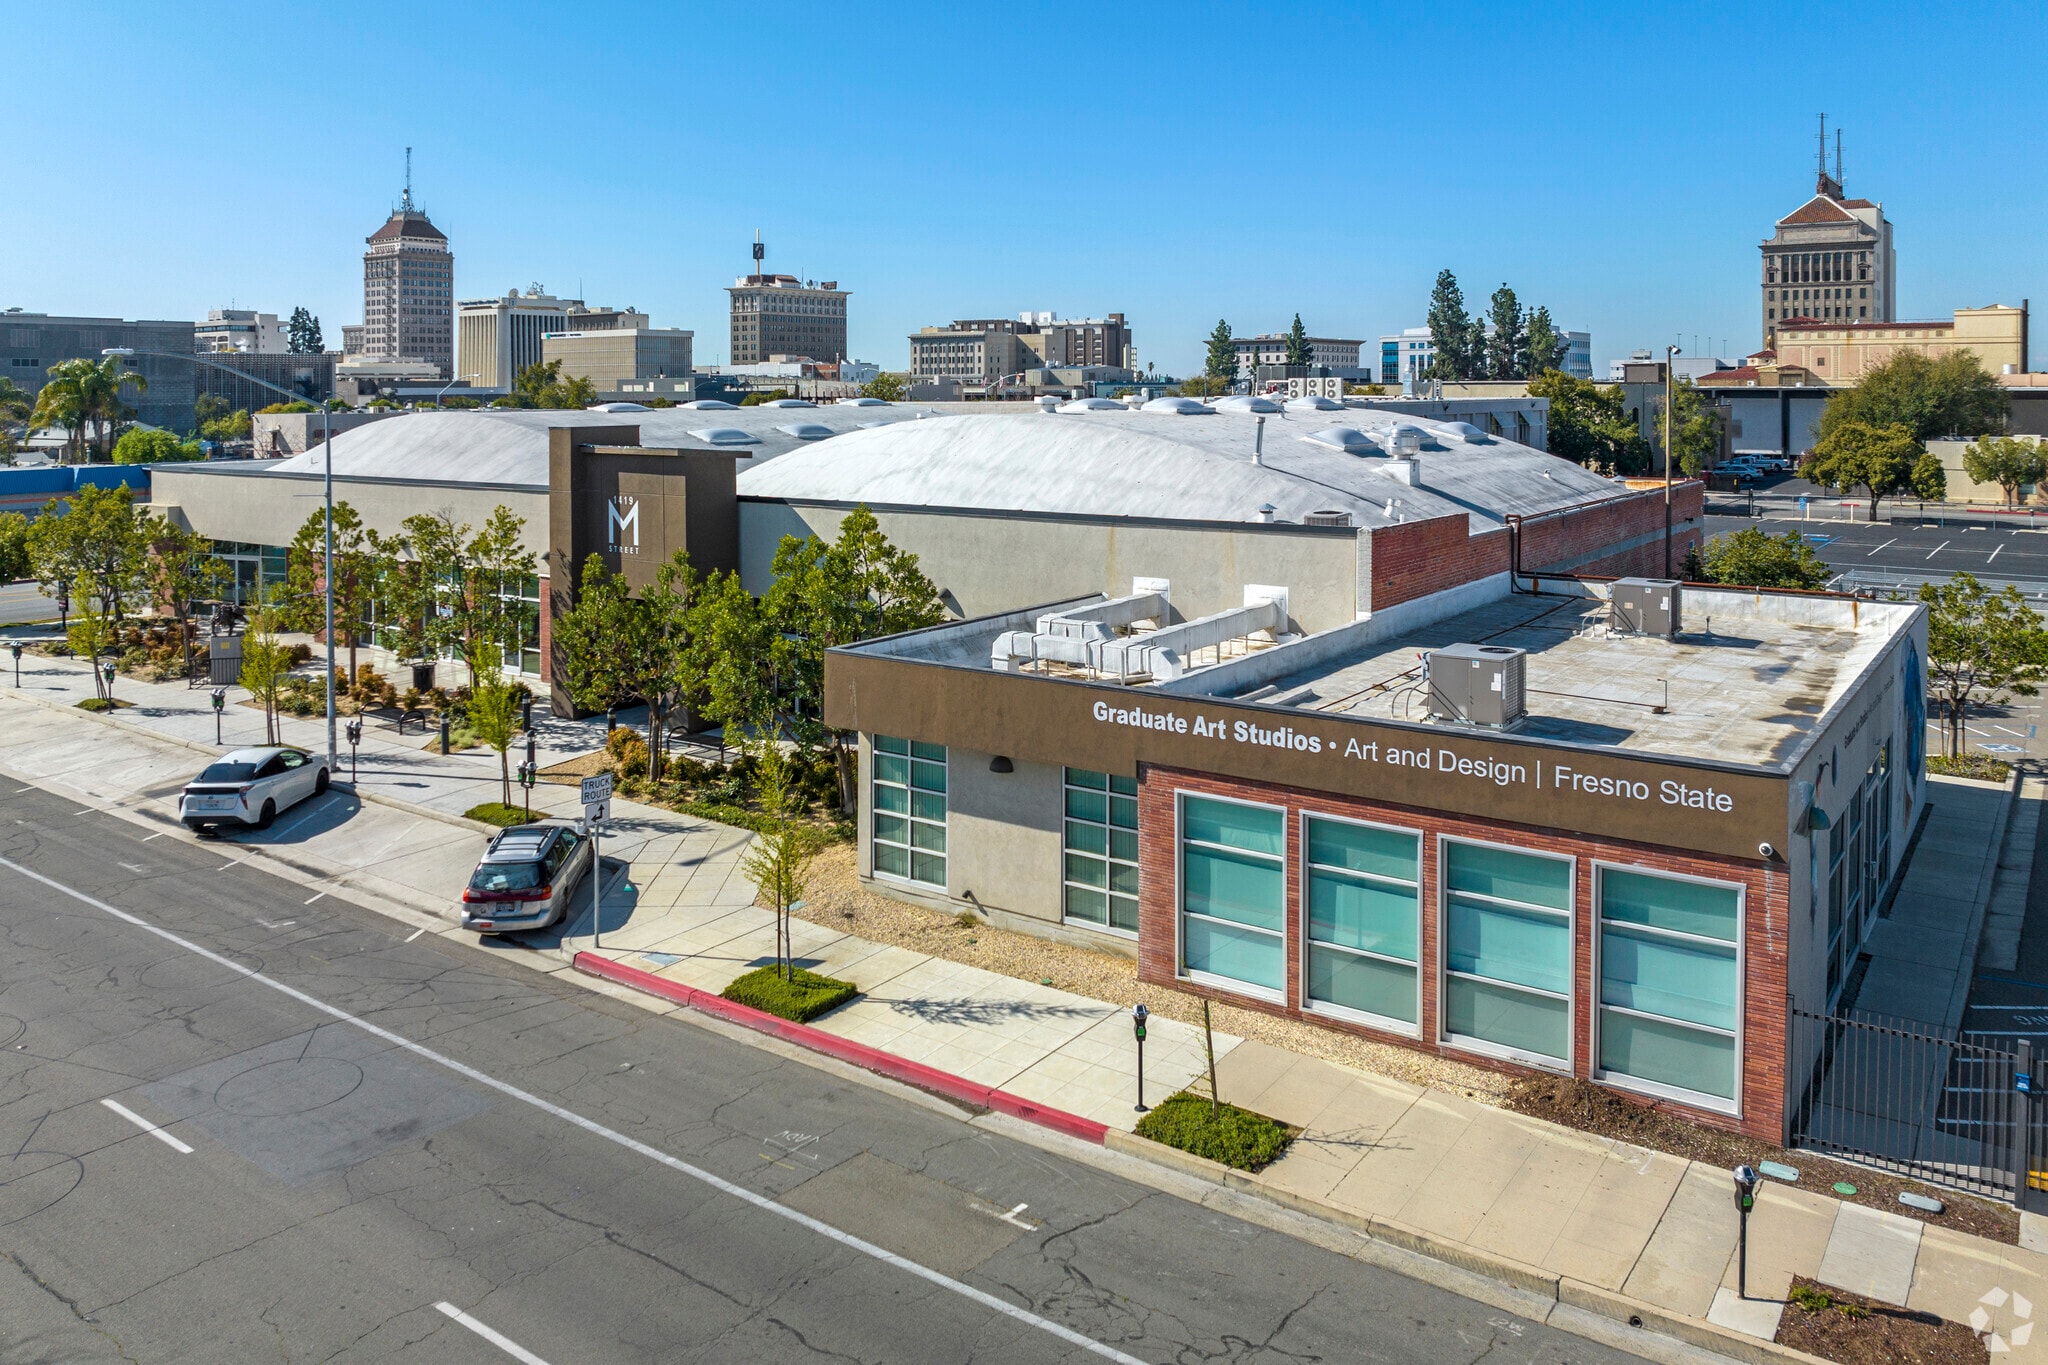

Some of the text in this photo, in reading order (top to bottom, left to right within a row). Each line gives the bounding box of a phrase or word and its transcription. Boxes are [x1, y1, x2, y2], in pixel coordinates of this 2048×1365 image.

[613, 495, 634, 505] 1419
[608, 498, 639, 546] M
[608, 545, 639, 555] STREET
[1093, 701, 1187, 734] Graduate
[1192, 715, 1227, 740] Art
[1233, 720, 1322, 753] Studios
[1343, 737, 1379, 762] Art
[1385, 747, 1431, 770] and
[1438, 749, 1526, 786] Design
[1555, 765, 1650, 800] Fresno
[1659, 780, 1733, 813] State
[584, 777, 610, 790] TRUCK
[584, 787, 610, 800] ROUTE
